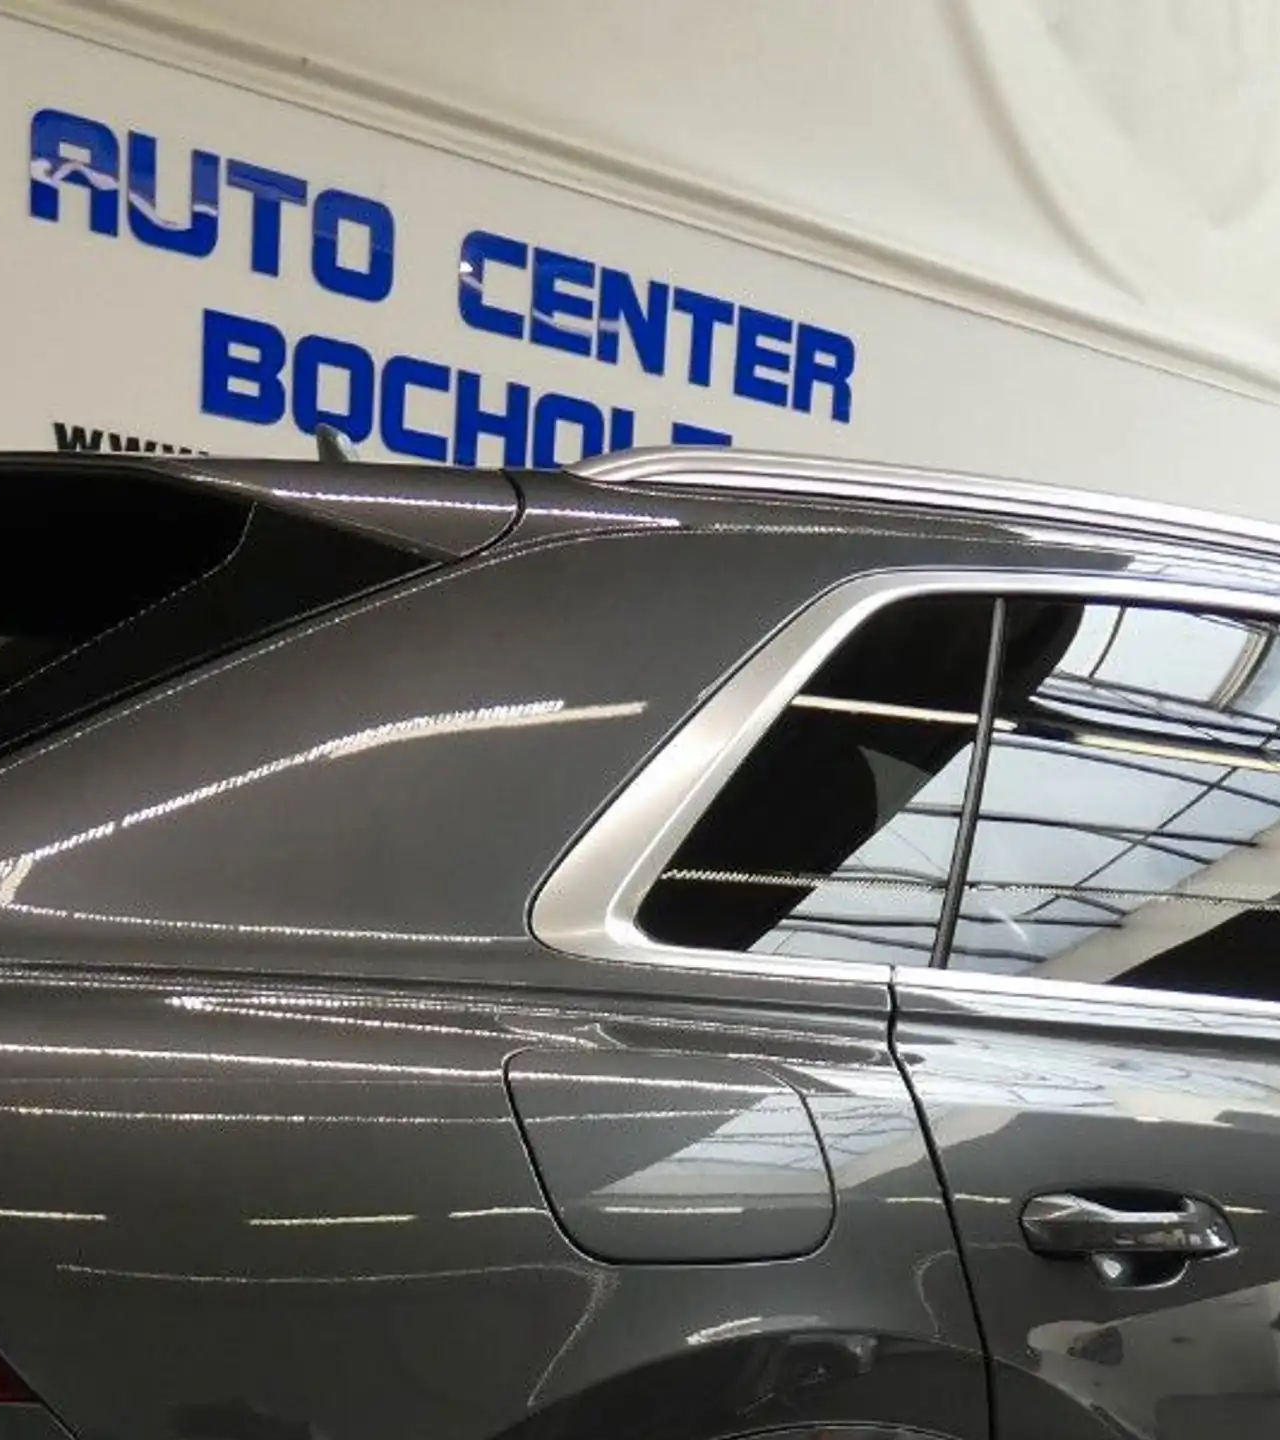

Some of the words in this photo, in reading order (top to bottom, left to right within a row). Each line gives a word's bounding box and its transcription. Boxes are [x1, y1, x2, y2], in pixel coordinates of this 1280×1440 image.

[30, 108, 395, 302] AUTO
[459, 230, 856, 423] CENTER
[202, 308, 733, 470] BOCHO
